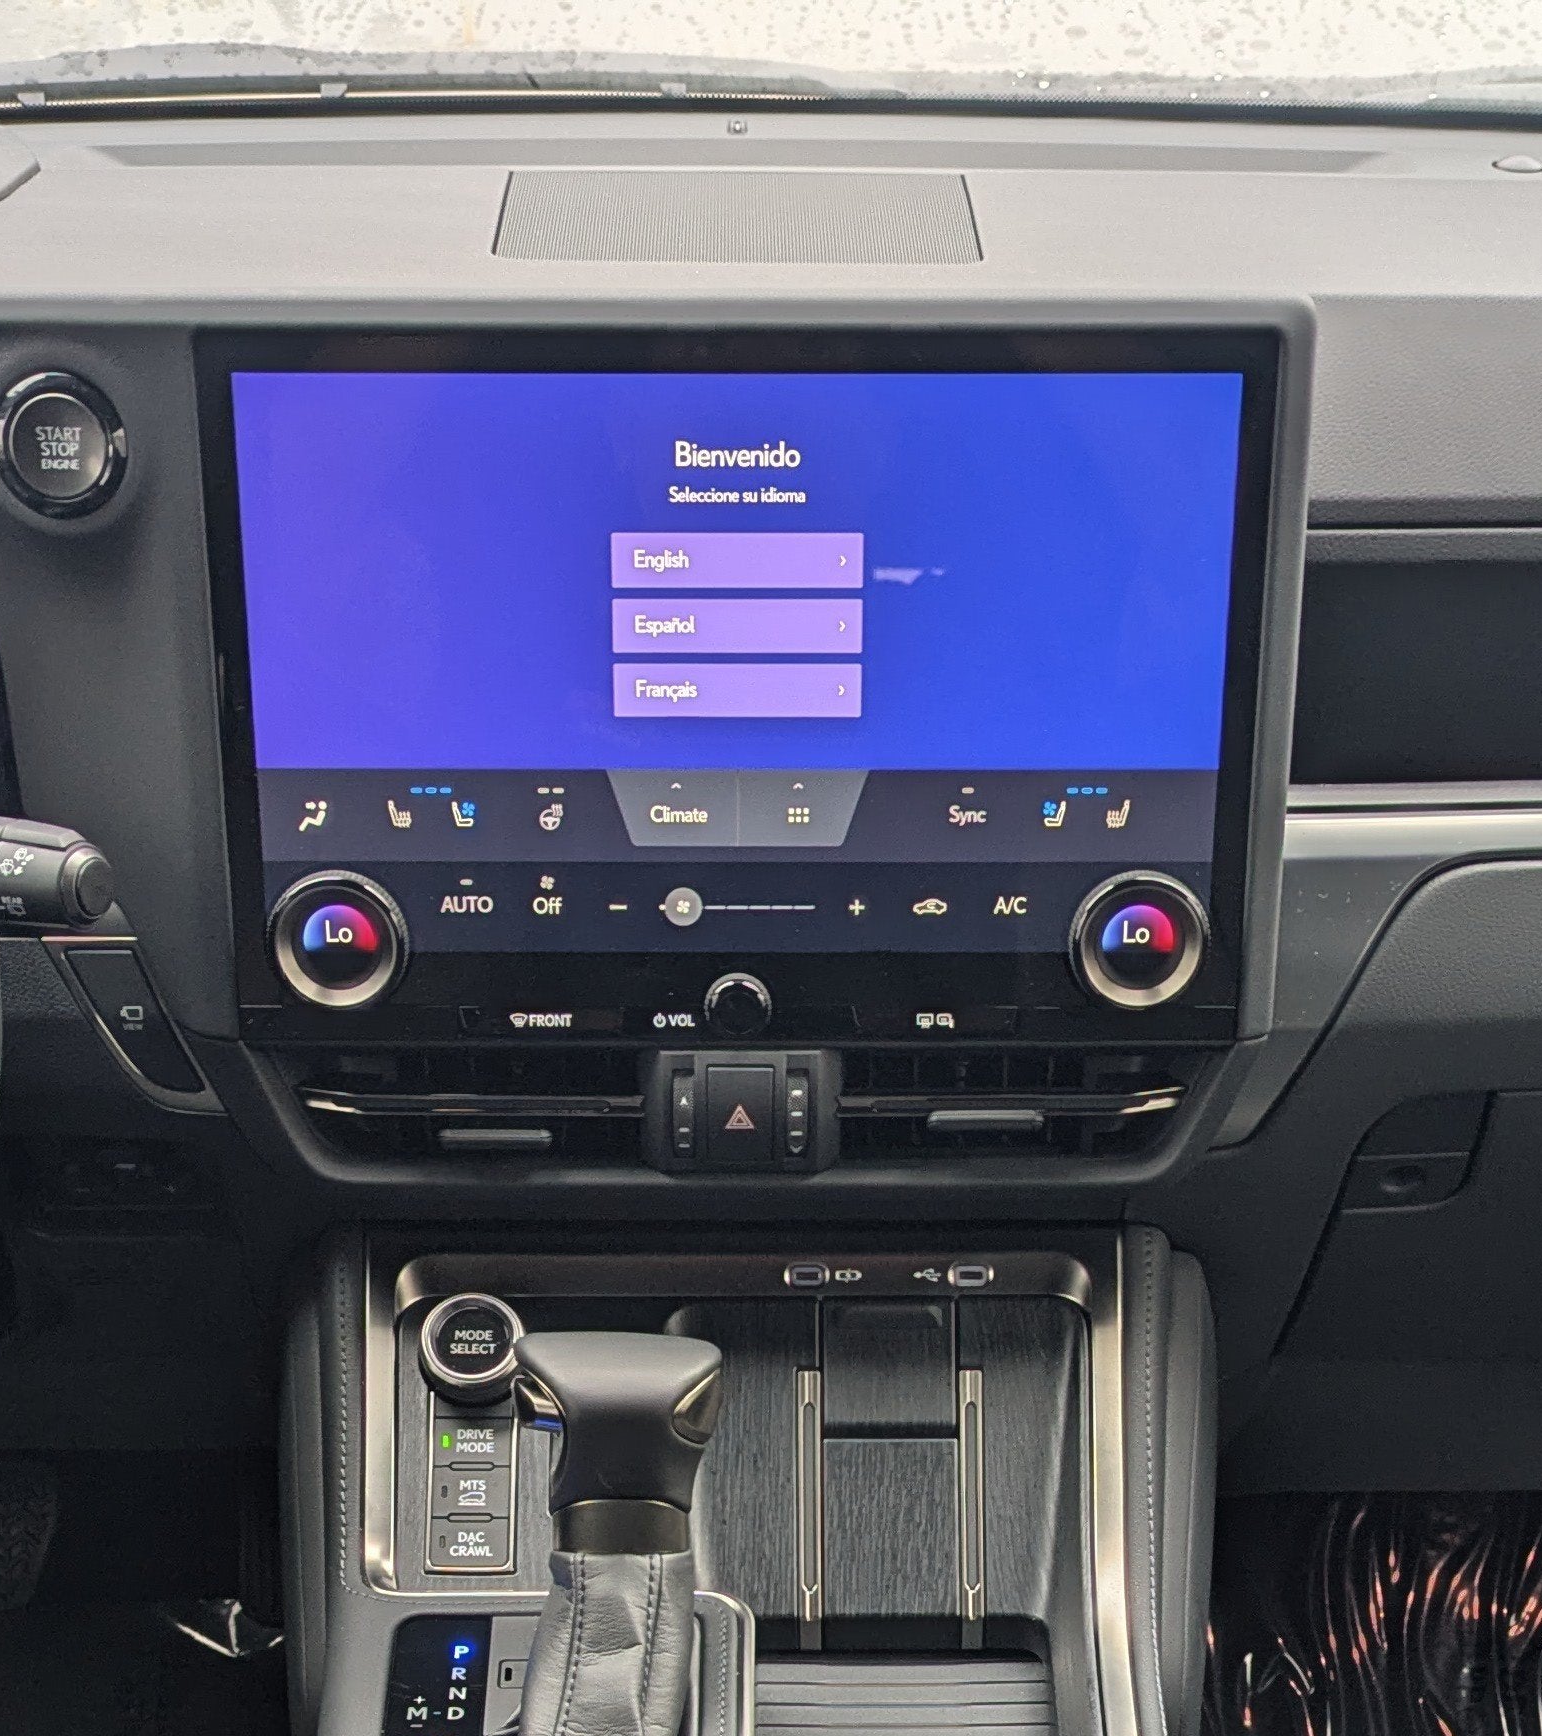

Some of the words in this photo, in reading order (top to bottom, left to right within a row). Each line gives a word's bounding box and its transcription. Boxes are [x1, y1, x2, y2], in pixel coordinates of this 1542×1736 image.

[35, 426, 82, 441] START
[40, 441, 79, 457] STOP
[674, 440, 801, 468] Bienvenido
[41, 458, 81, 470] ENGINE
[668, 486, 740, 503] Seleccione
[742, 490, 757, 503] su
[760, 487, 806, 503] idioma
[633, 550, 690, 573] English
[634, 614, 695, 638] Español
[635, 679, 698, 703] Français
[649, 806, 708, 824] Climate
[948, 805, 987, 827] Sync
[440, 896, 494, 915] AUTO
[532, 897, 563, 916] Off
[993, 896, 1028, 915] A/C
[325, 920, 353, 944] Lo
[1122, 920, 1150, 944] Lo
[529, 1012, 573, 1028] FRONT
[668, 1013, 696, 1028] VOL
[454, 1330, 493, 1342] MODE
[449, 1342, 496, 1355] SELECT
[457, 1429, 494, 1440] DRIVE
[455, 1442, 495, 1453] MODE
[459, 1479, 486, 1491] MTS
[457, 1532, 485, 1544] DAC
[449, 1546, 494, 1558] CRAWL
[454, 1645, 470, 1659] P
[451, 1667, 467, 1680] R
[448, 1687, 467, 1701] N
[406, 1706, 428, 1720] M
[446, 1706, 465, 1720] D
